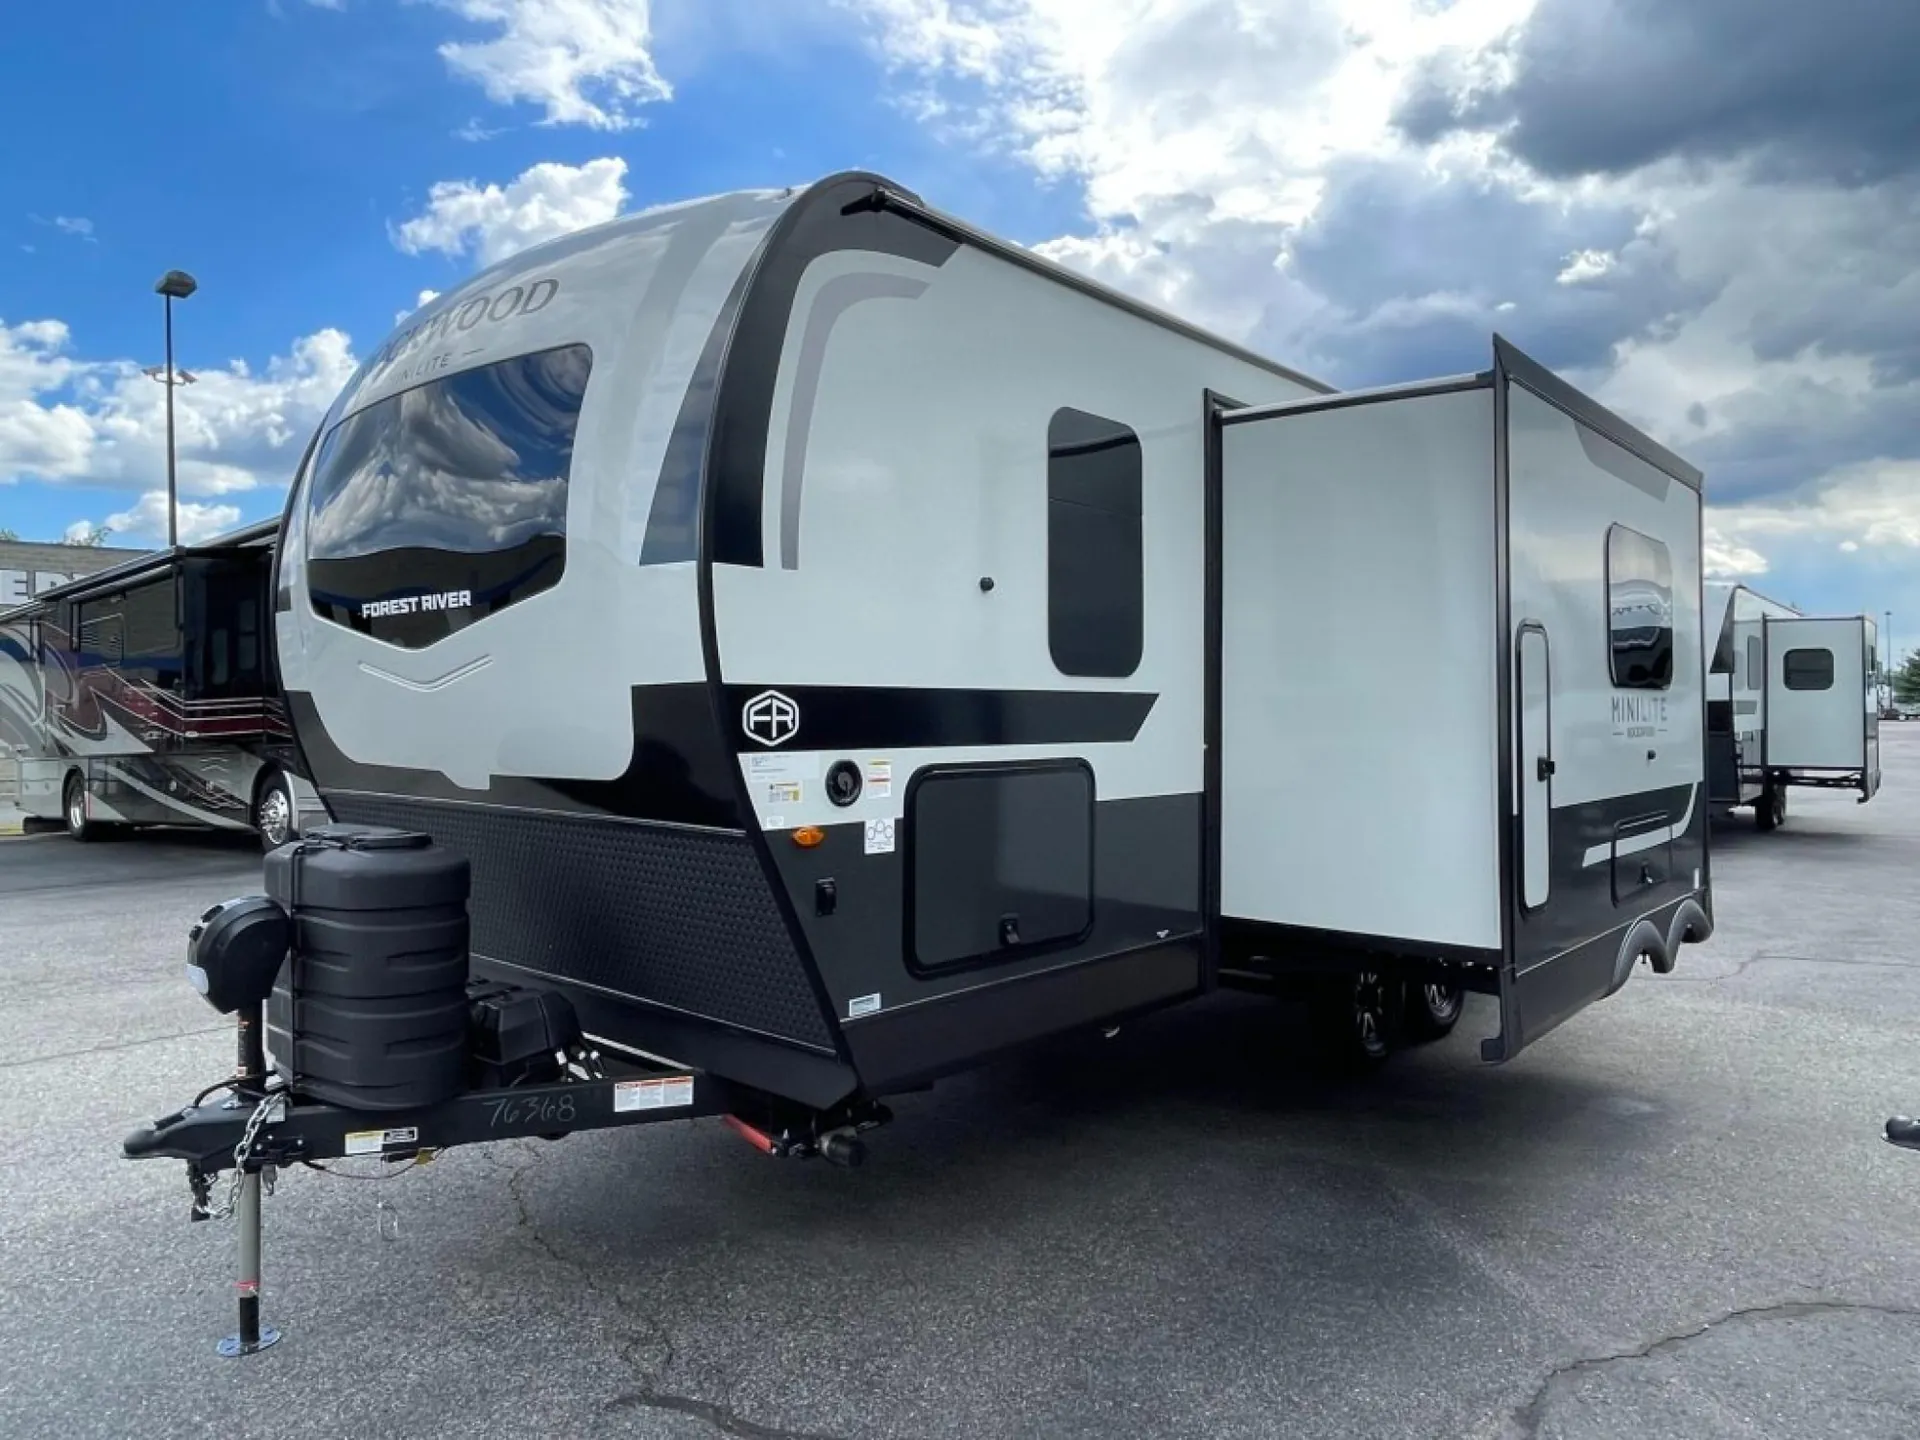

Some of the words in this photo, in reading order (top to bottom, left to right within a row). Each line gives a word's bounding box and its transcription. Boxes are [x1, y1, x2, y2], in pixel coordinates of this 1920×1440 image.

[361, 597, 419, 619] FOREST
[421, 590, 471, 611] RIVER
[1611, 696, 1668, 723] MINILITE
